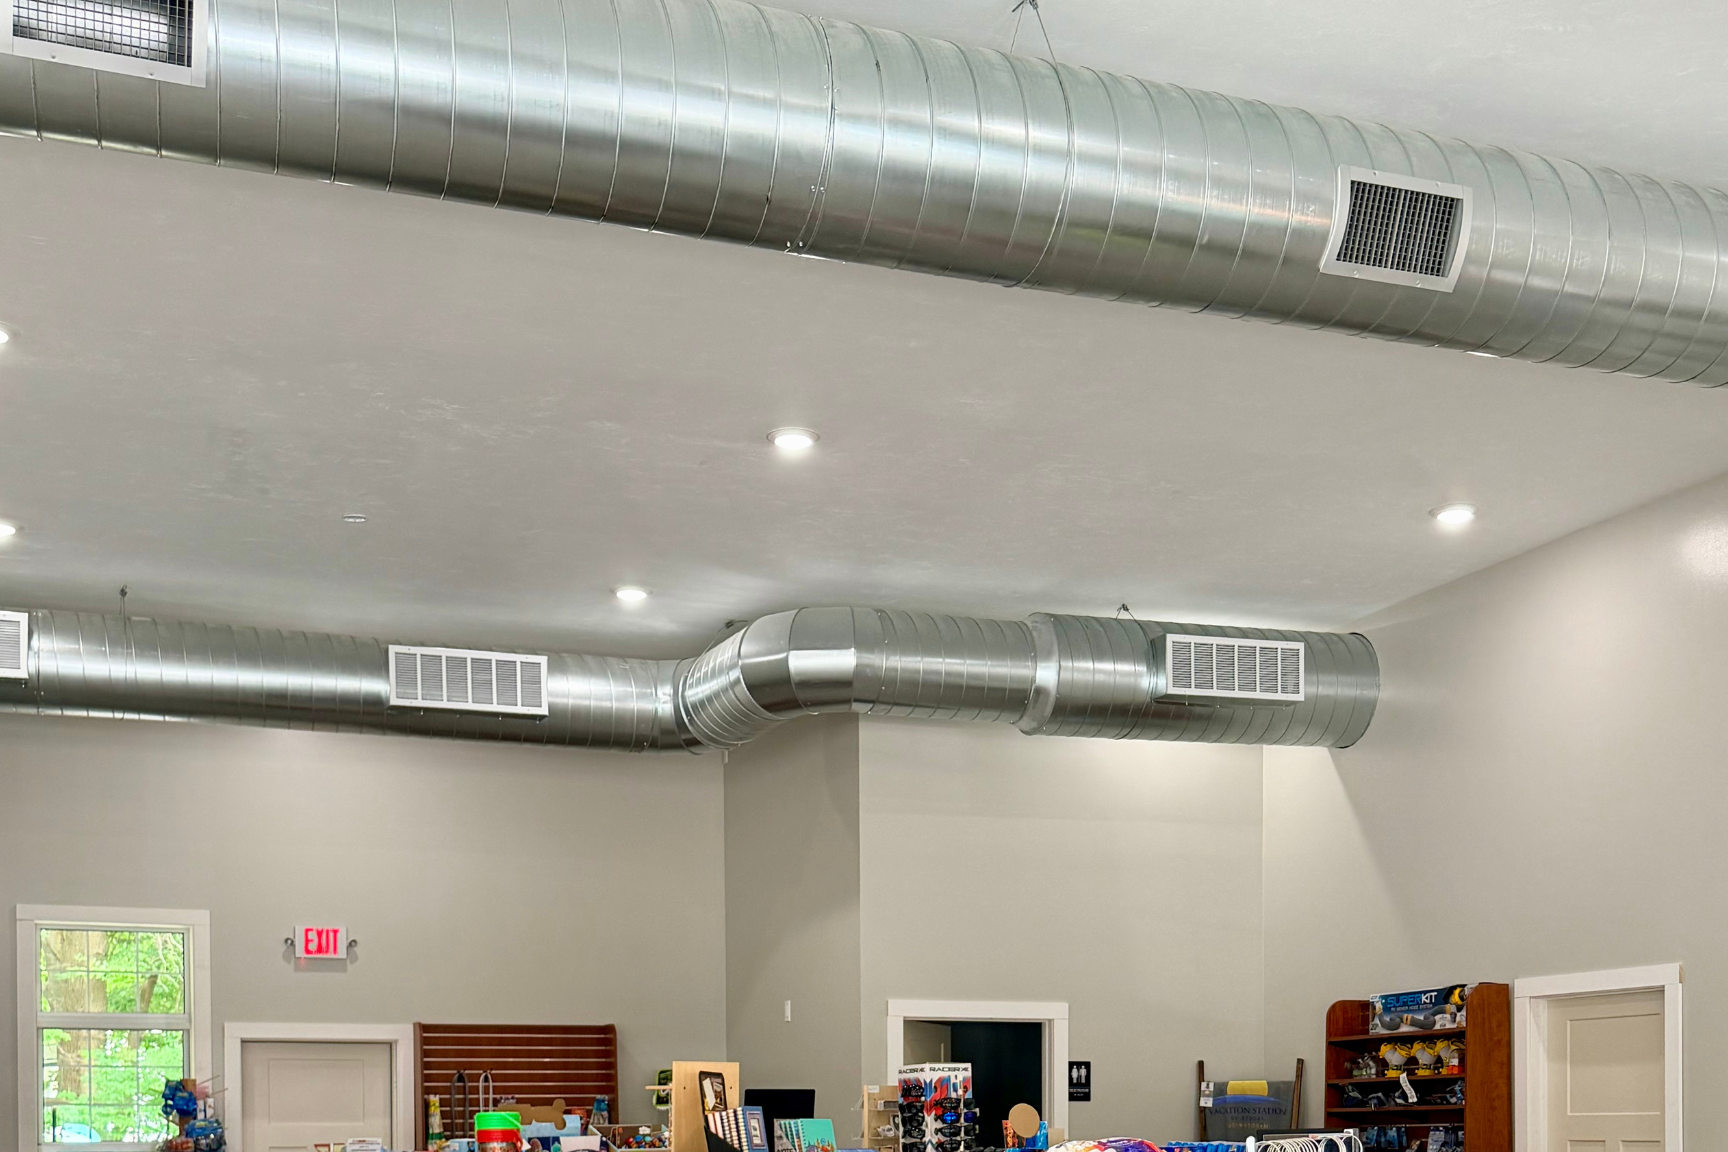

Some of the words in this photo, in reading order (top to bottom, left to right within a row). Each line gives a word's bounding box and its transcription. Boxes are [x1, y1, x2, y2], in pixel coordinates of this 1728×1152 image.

[304, 928, 340, 955] EXIT
[1208, 1106, 1250, 1116] VACATION
[1252, 1106, 1287, 1116] STATION
